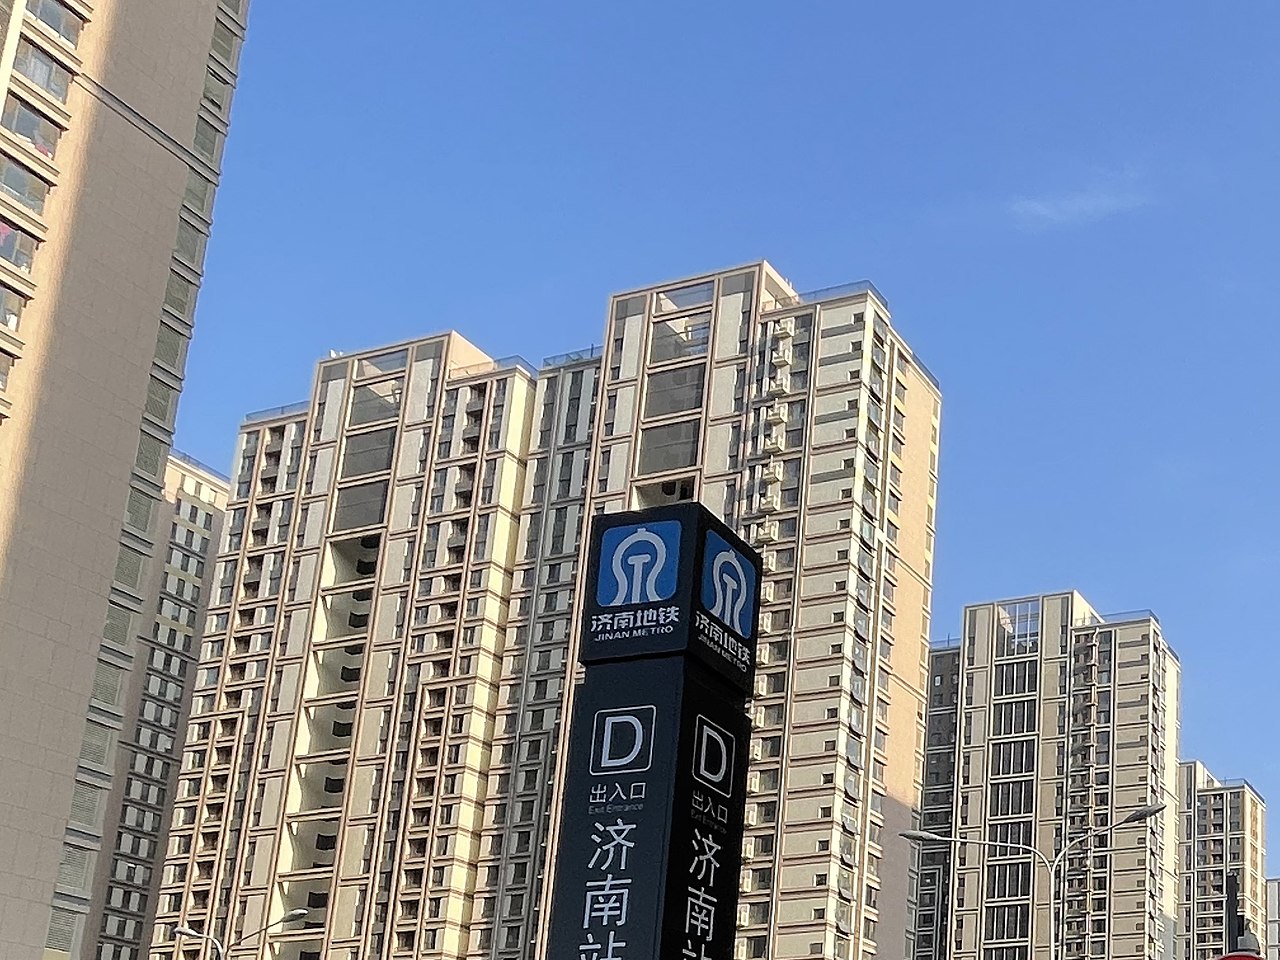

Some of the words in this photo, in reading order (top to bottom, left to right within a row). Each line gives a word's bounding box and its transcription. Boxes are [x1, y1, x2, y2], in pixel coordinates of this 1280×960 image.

[591, 605, 679, 632] 济南地铁
[595, 630, 630, 642] JINAN
[632, 624, 674, 637] METRO
[695, 610, 751, 666] 济南地铁
[601, 715, 643, 767] D
[700, 725, 727, 782] D
[590, 782, 646, 803] 出入口
[692, 790, 728, 824] 出入口
